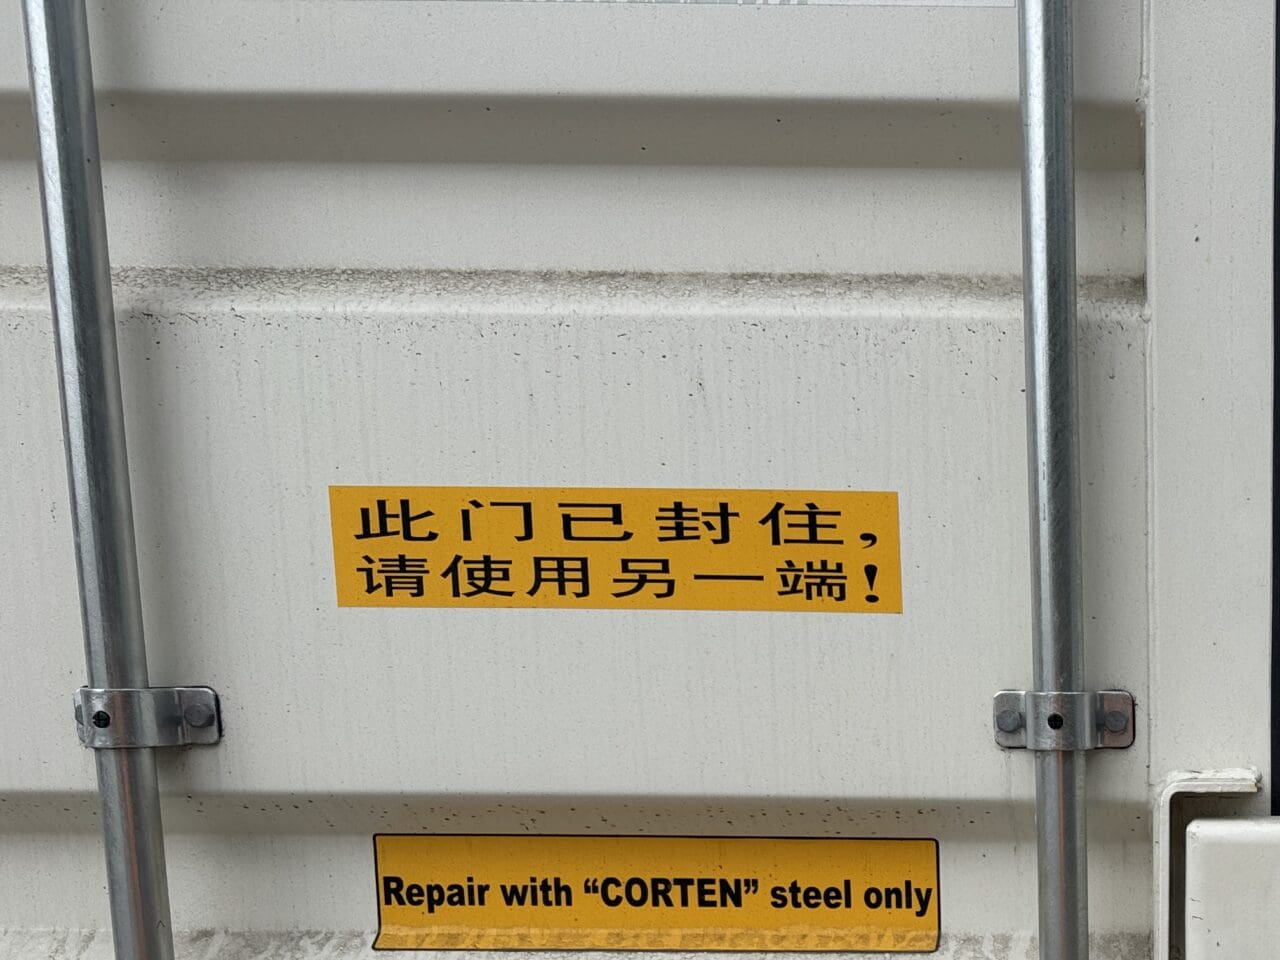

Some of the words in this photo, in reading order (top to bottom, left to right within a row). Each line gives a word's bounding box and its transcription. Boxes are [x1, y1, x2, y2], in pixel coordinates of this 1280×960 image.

[382, 875, 491, 914] Repair
[499, 876, 573, 907] with
[583, 876, 759, 908] “CORTEN”
[770, 879, 852, 909] steel
[863, 879, 933, 918] only
